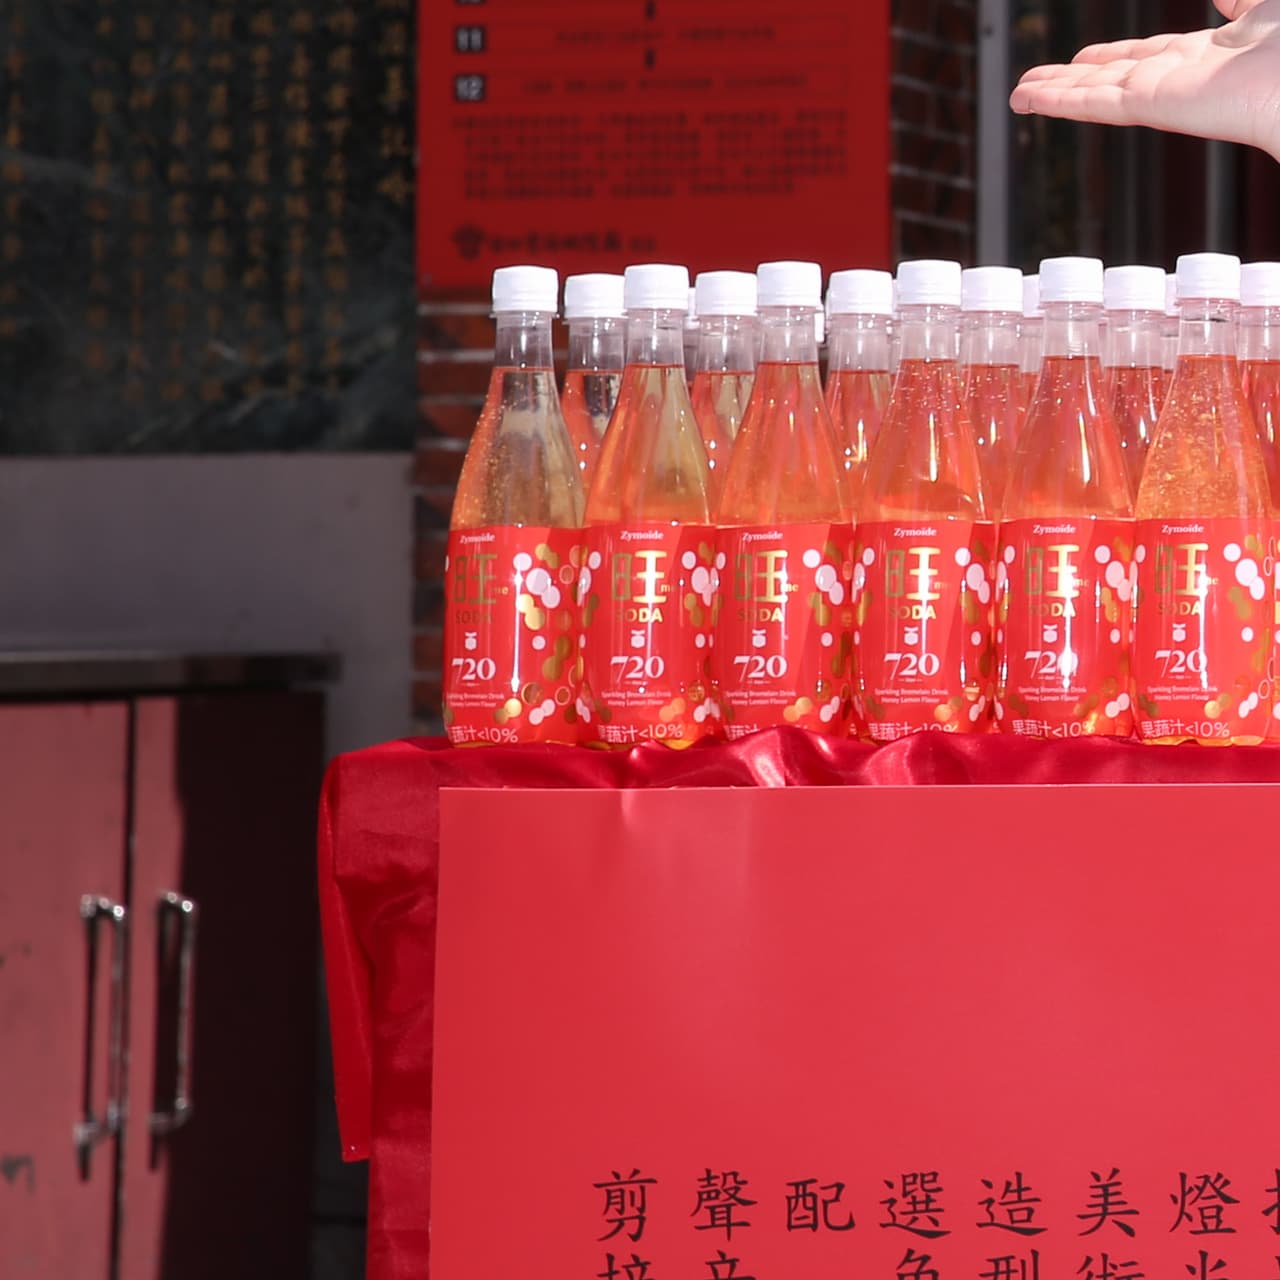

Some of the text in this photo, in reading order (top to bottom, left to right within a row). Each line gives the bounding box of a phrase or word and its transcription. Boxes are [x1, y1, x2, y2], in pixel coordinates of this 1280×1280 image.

[451, 657, 496, 684] 720
[610, 656, 665, 684] 720
[733, 655, 788, 683] 720
[883, 653, 940, 681] 720
[1023, 651, 1079, 679] 720
[1154, 649, 1208, 678] 720
[785, 1178, 856, 1233] 配
